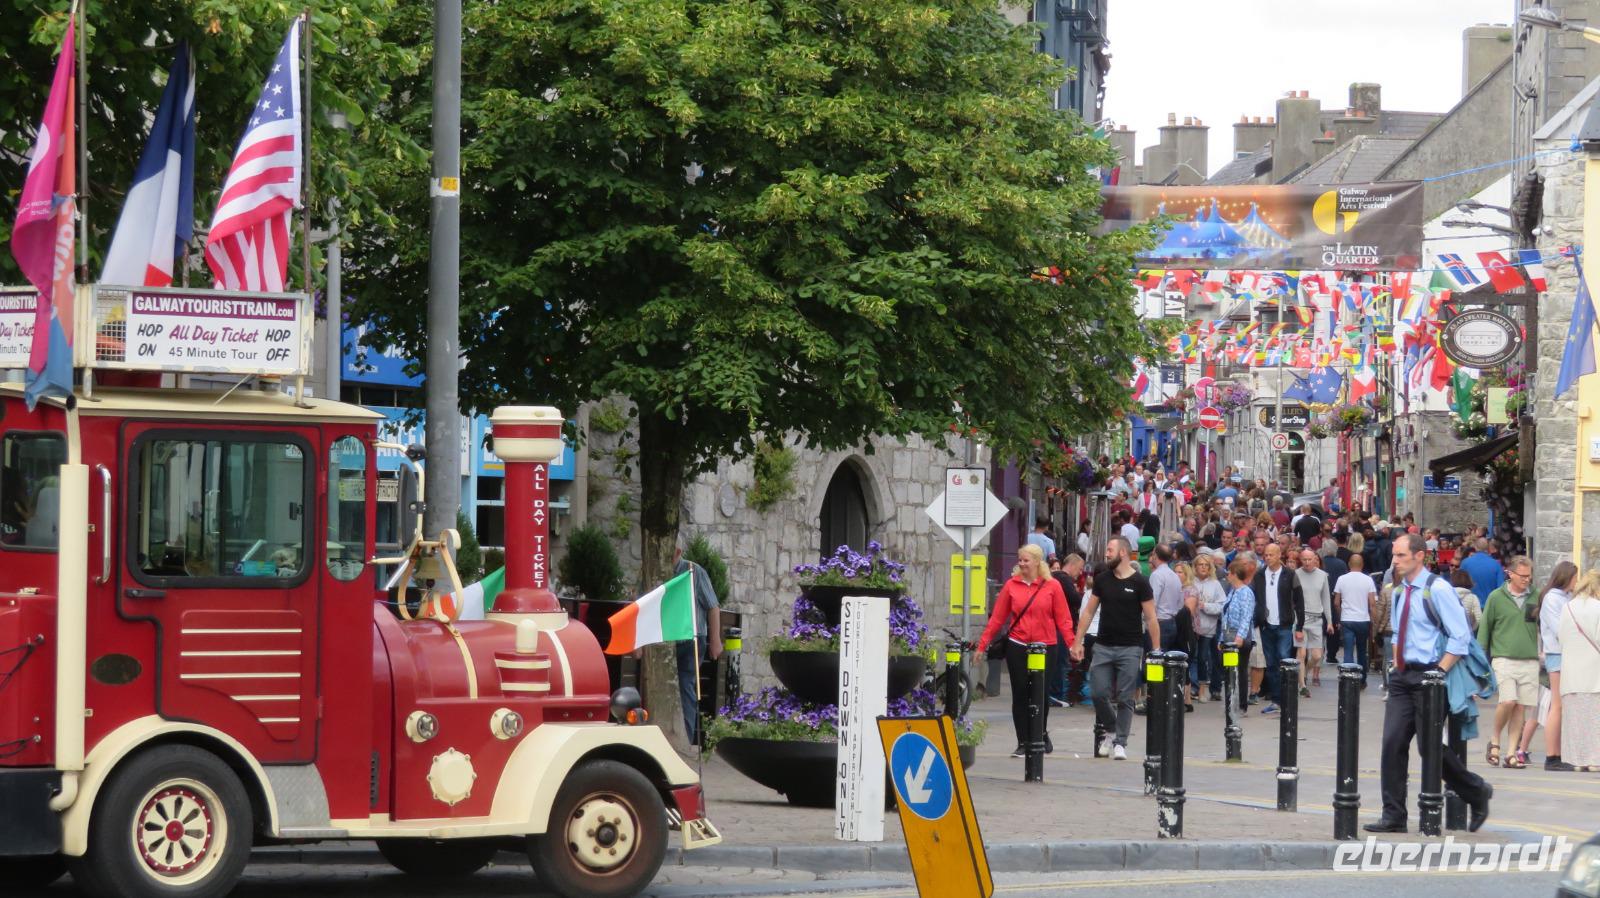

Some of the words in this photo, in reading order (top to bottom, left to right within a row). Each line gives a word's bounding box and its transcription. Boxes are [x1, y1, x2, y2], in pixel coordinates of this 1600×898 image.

[1340, 188, 1368, 197] Galway
[1340, 194, 1392, 202] International
[1336, 242, 1378, 256] LATIN
[1322, 252, 1380, 266] QUARTER
[135, 296, 294, 318] GALWAYTOURISTTRAIN.COM
[137, 323, 164, 337] HOP
[1464, 314, 1490, 322] SWEATER
[1492, 316, 1513, 334] MARKET
[168, 324, 190, 340] All
[192, 325, 219, 344] Day
[220, 327, 259, 343] Ticket
[265, 328, 291, 342] HOP
[138, 342, 157, 356] ON
[168, 346, 183, 357] 45
[186, 347, 227, 359] Minute
[231, 348, 258, 360] Tour
[266, 348, 291, 362] OFF
[534, 464, 544, 490] ALL
[534, 500, 544, 526] DAY
[534, 536, 544, 588] TICKET
[840, 671, 850, 747] DOWN
